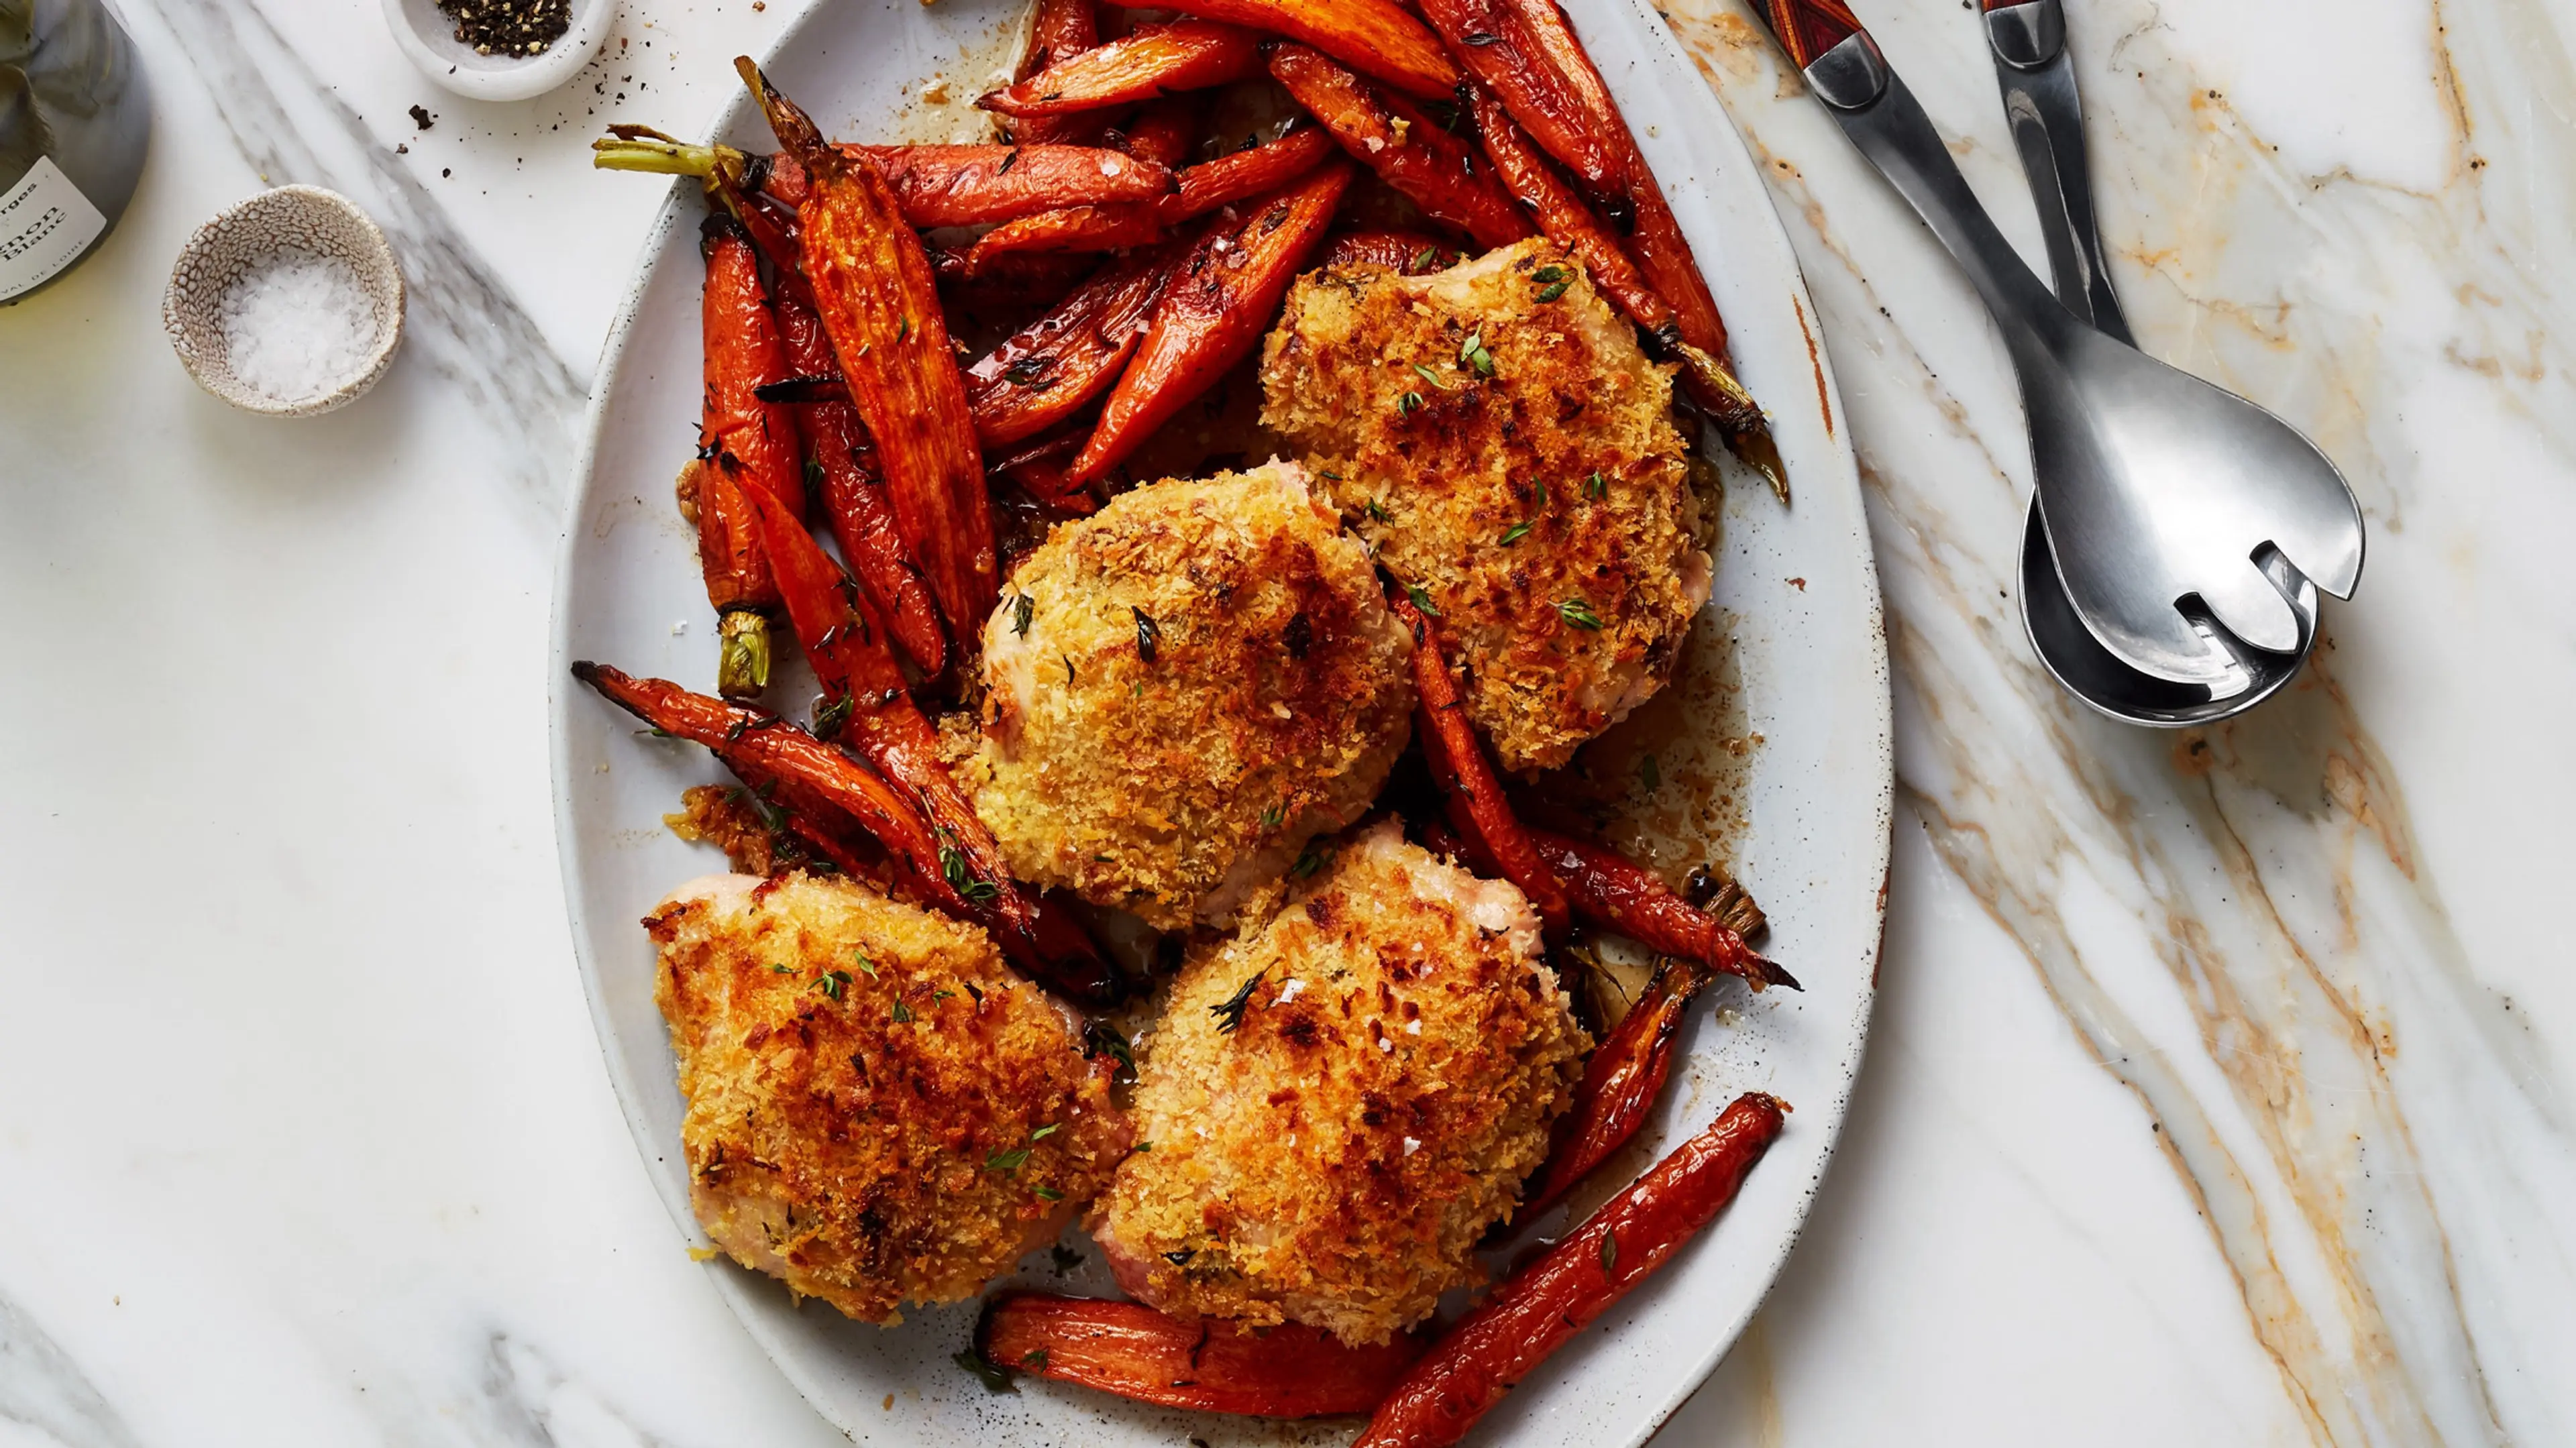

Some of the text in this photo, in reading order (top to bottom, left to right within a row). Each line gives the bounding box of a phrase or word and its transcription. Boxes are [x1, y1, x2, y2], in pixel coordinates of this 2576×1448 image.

[0, 183, 37, 216] rges
[3, 212, 66, 262] Blanc
[1, 239, 83, 294] VAL DE LOIRE
